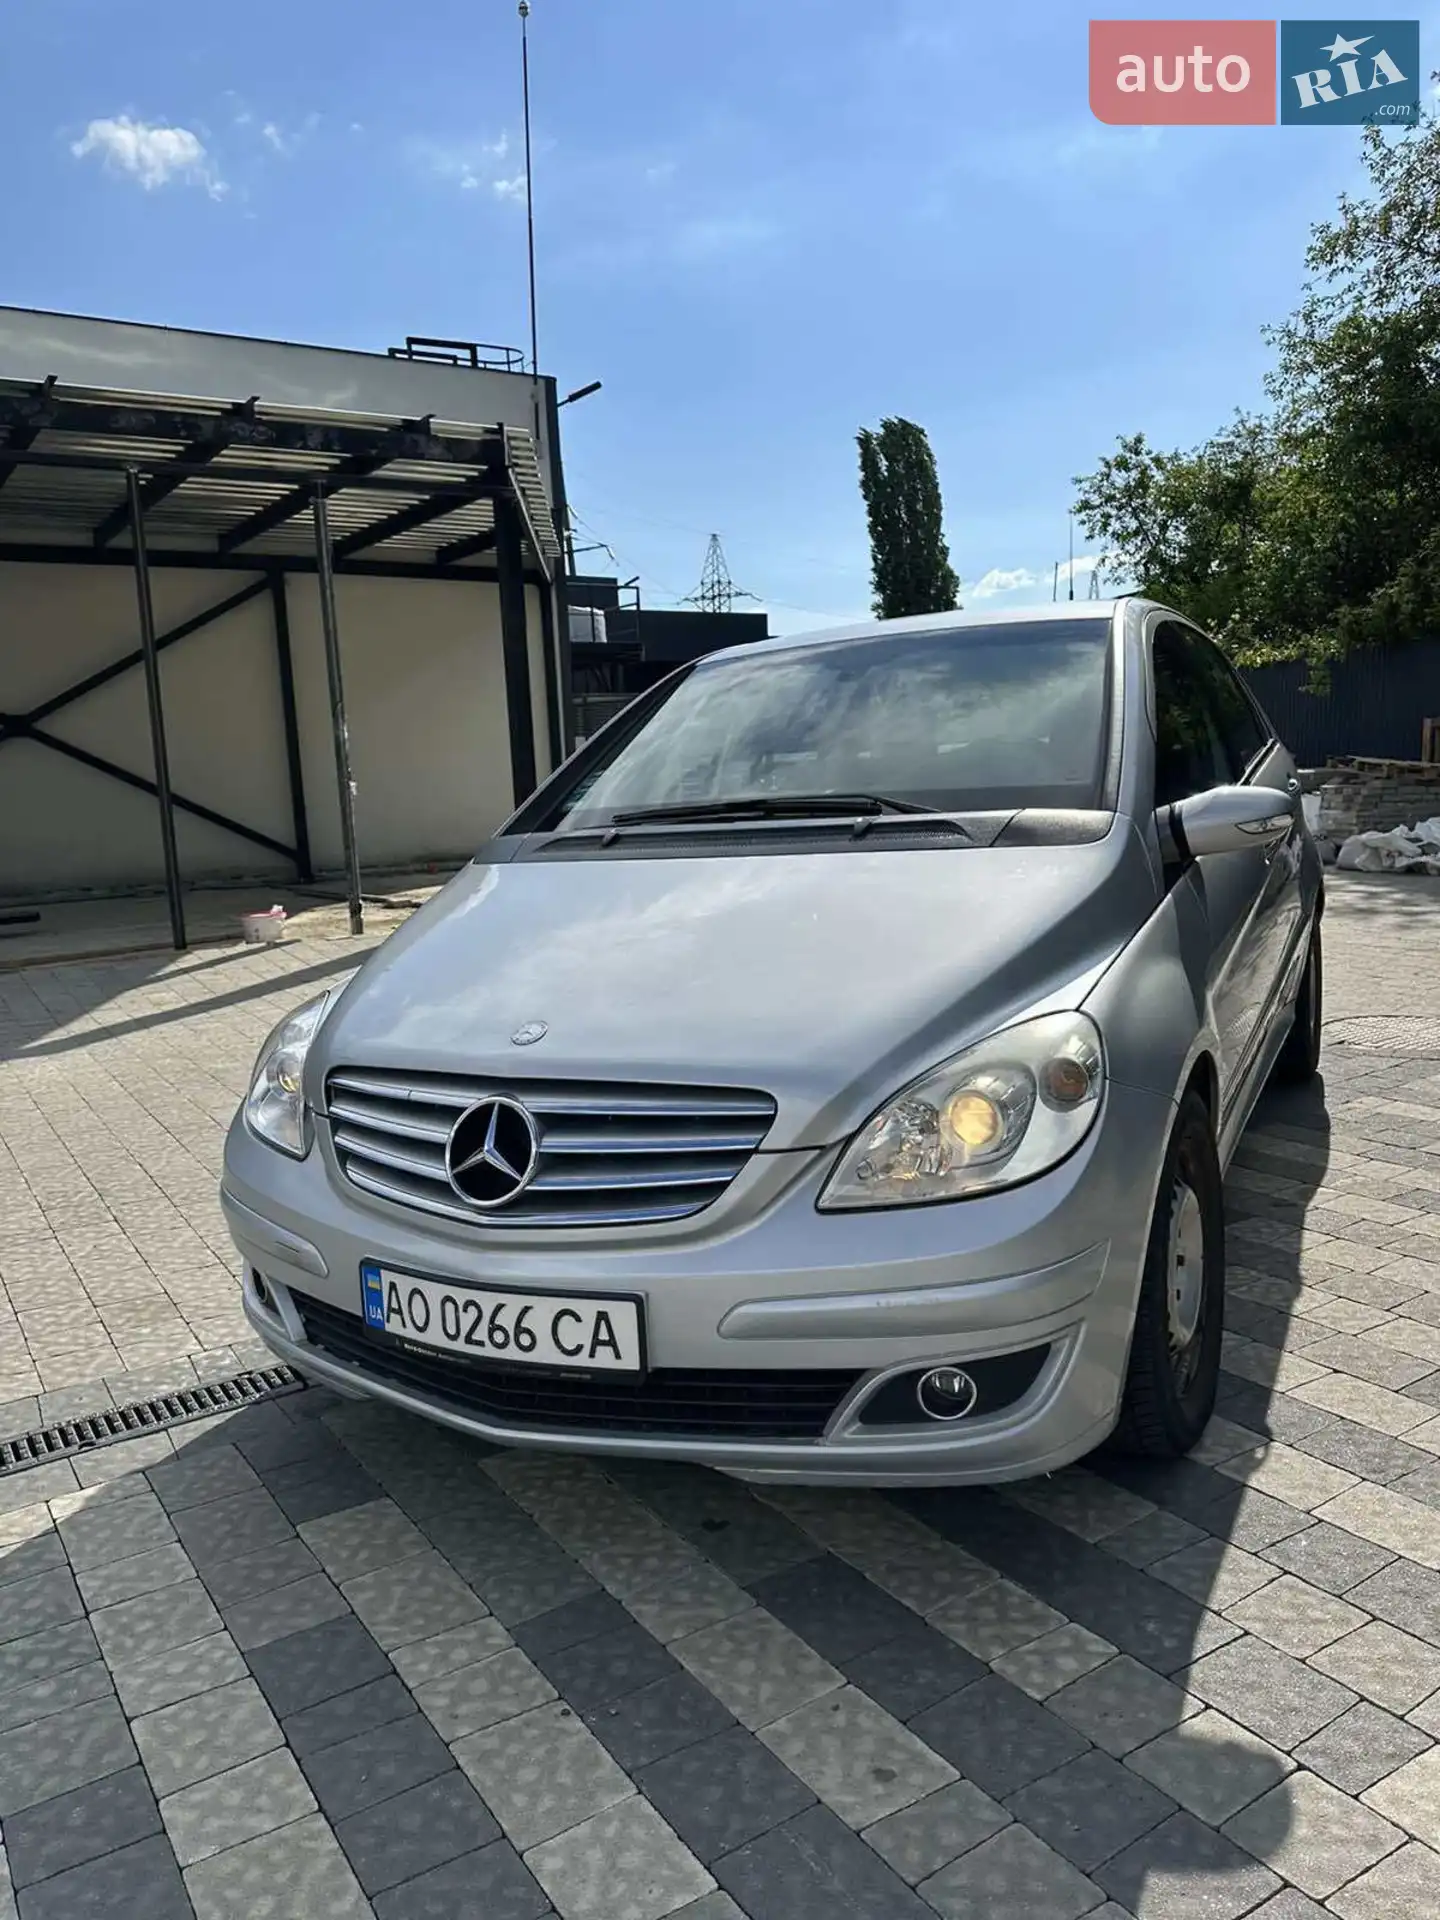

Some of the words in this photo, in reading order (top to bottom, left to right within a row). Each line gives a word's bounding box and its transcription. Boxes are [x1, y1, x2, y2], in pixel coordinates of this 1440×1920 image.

[368, 1304, 384, 1321] UA
[386, 1280, 431, 1334] AO
[441, 1294, 538, 1353] 0266
[551, 1308, 622, 1360] CA
